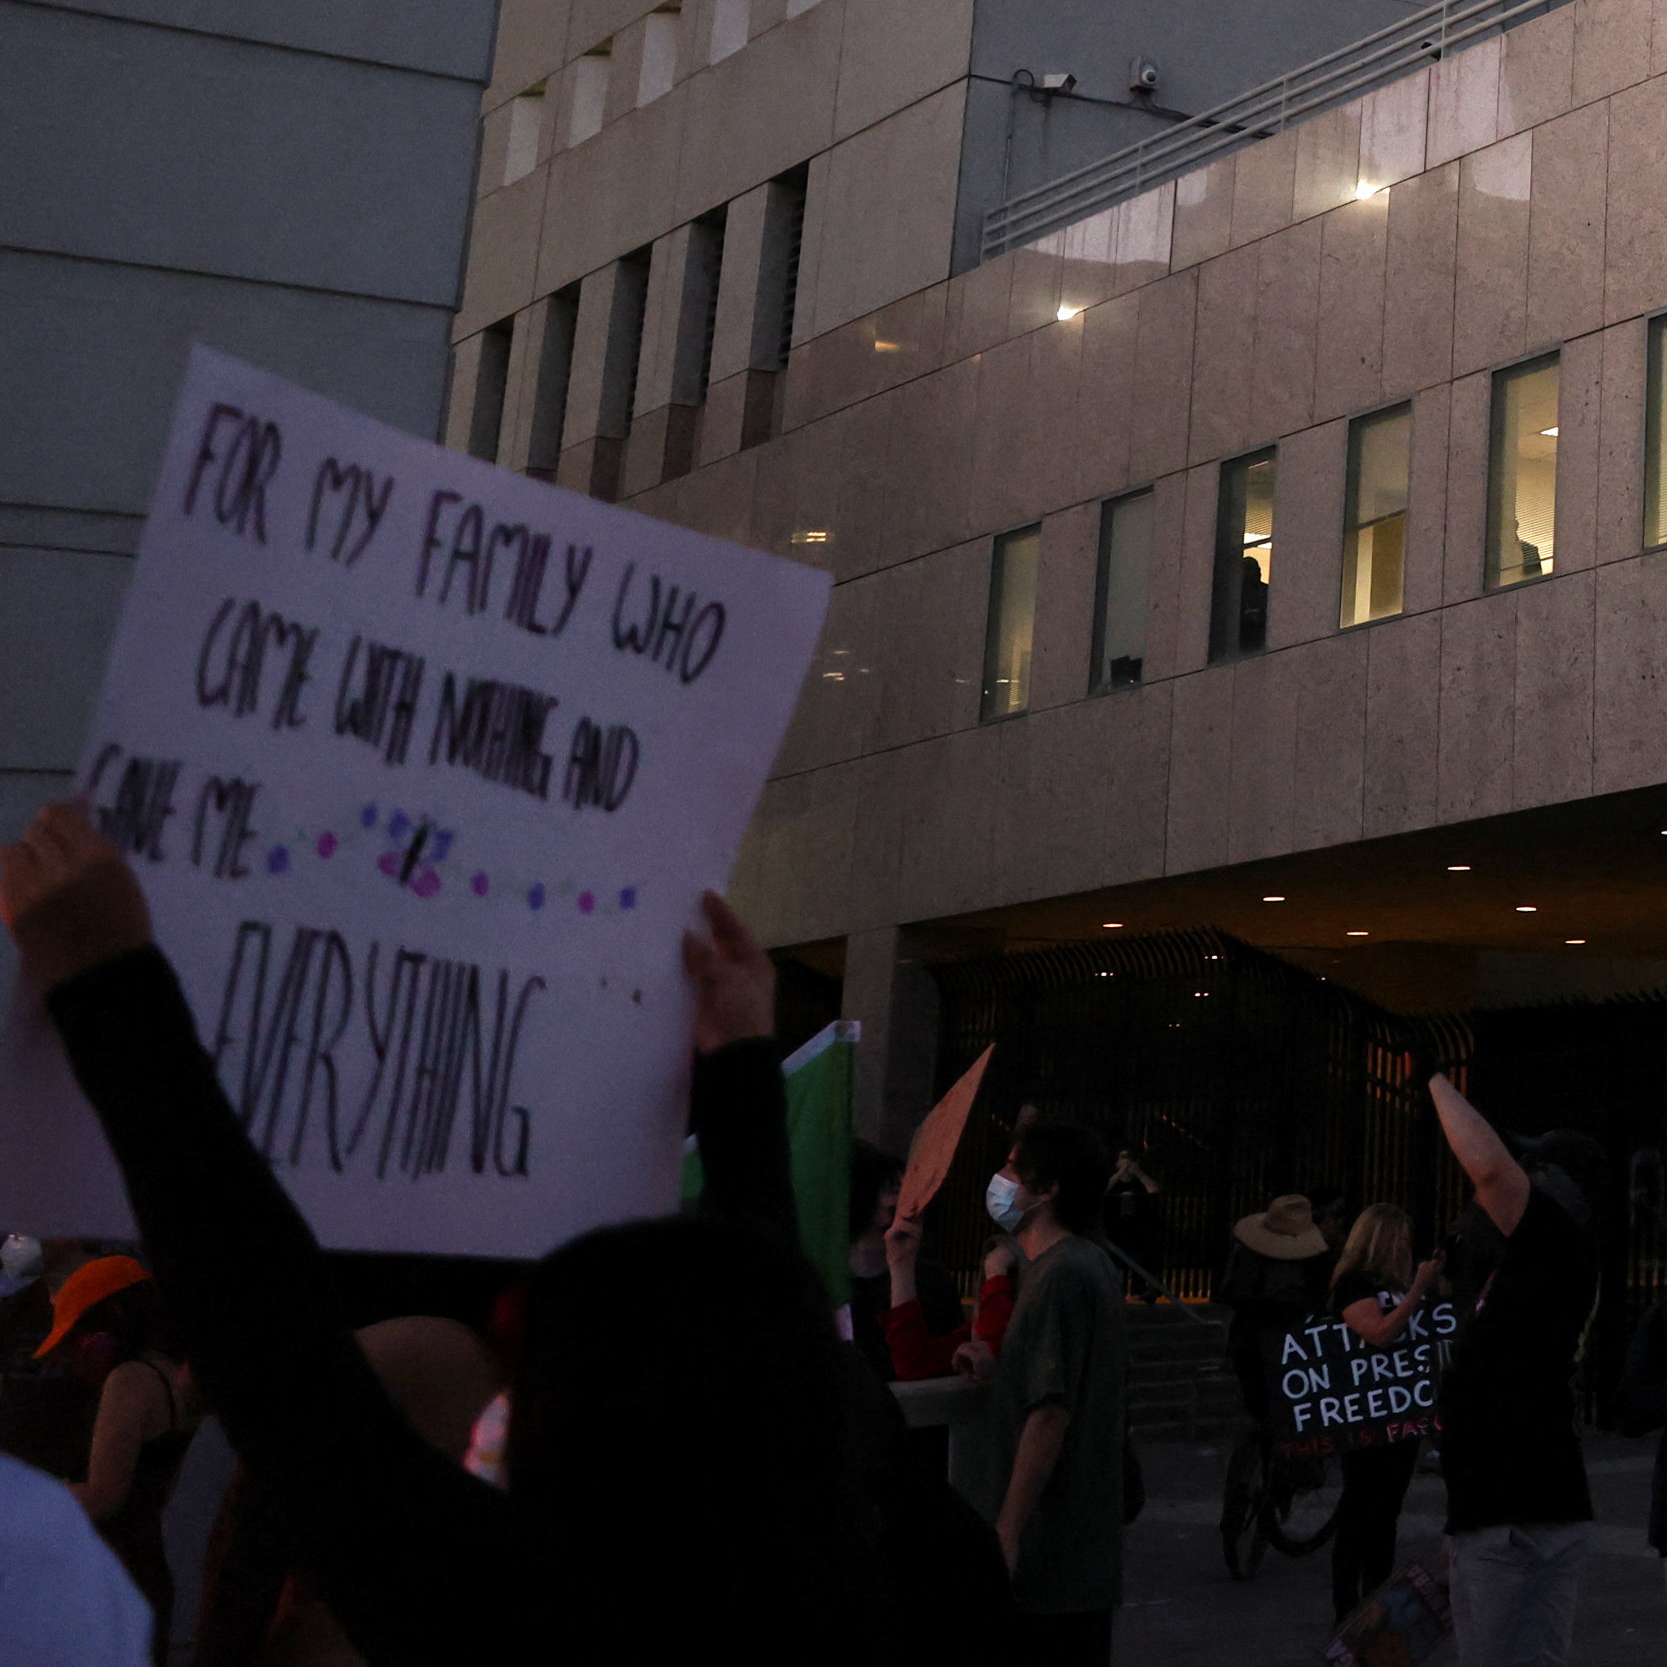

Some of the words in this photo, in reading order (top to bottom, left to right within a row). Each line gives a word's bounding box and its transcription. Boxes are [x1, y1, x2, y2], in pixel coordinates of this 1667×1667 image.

[183, 402, 282, 545] FOR
[306, 456, 395, 567] MY
[415, 490, 593, 637] FAMILY
[612, 561, 727, 684] WHO
[196, 597, 320, 730] CAME
[335, 635, 425, 766] WITH
[429, 671, 559, 801] NOTHING
[563, 716, 639, 813] AND
[191, 775, 262, 879] ME
[215, 920, 547, 1182] EVERYTHING
[1281, 1302, 1458, 1365] ATTKS
[1282, 1364, 1331, 1400] ON
